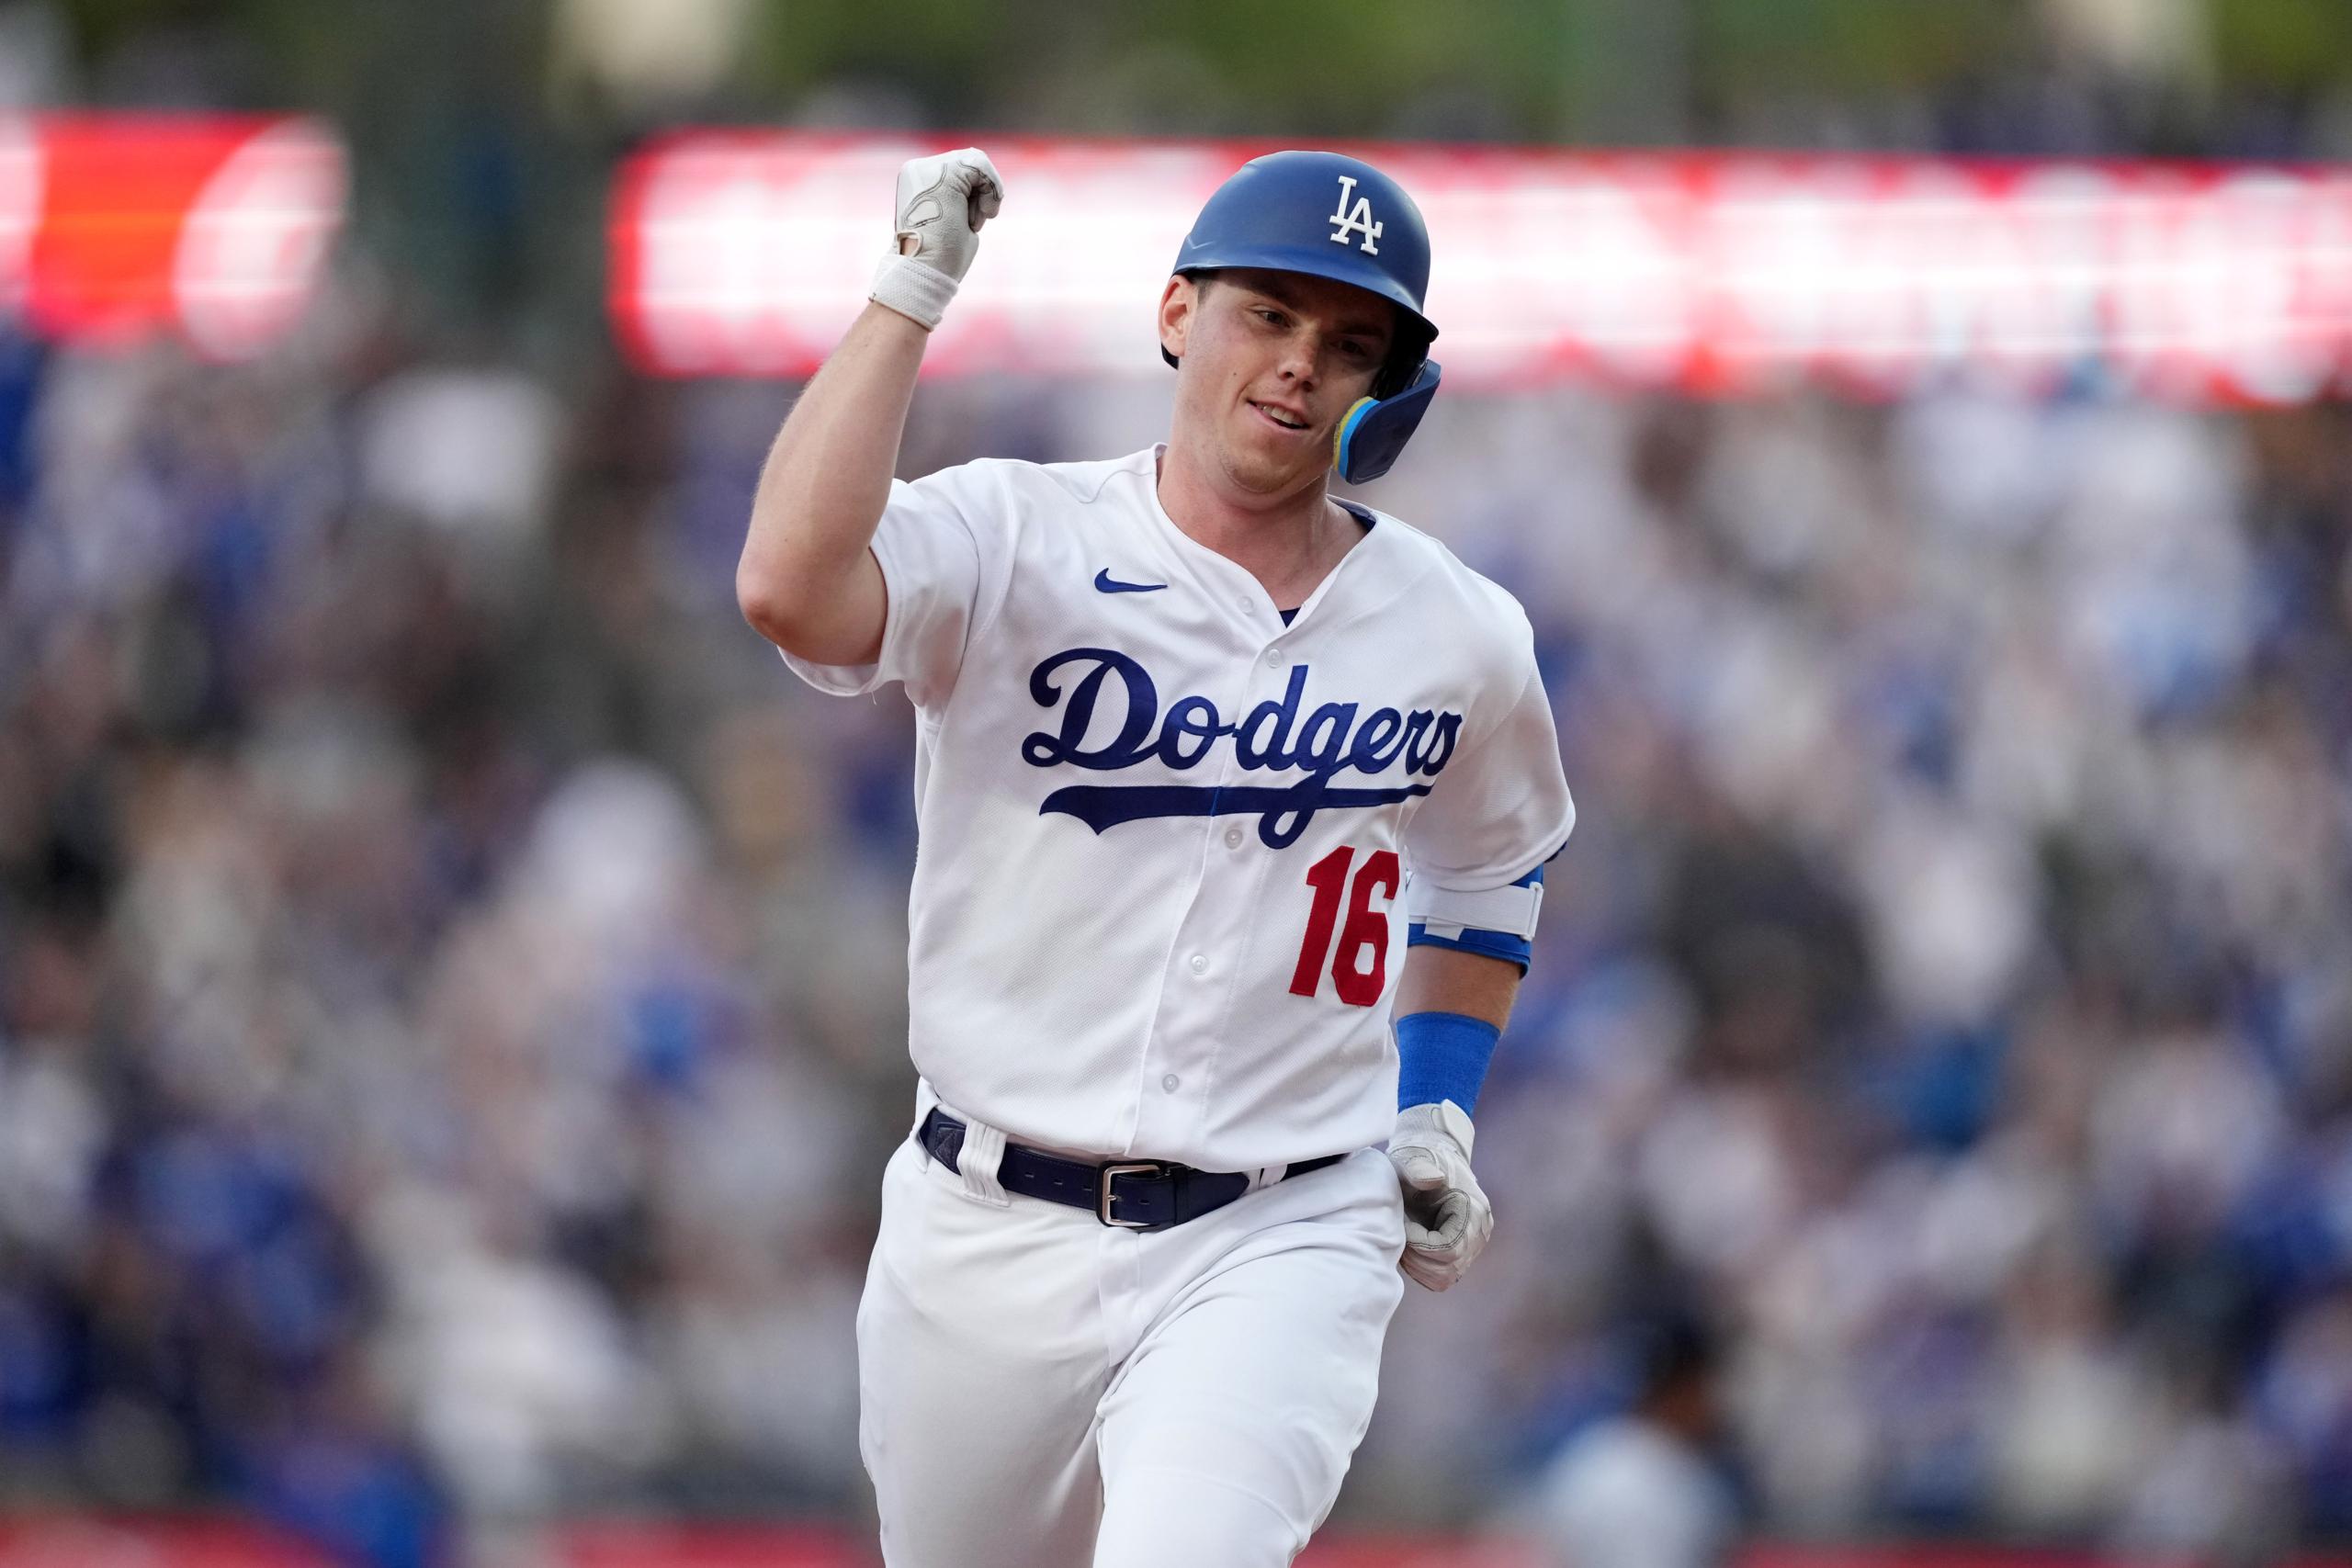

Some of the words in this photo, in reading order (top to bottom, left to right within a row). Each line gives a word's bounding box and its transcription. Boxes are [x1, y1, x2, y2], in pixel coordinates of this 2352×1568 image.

[1329, 175, 1384, 256] LA
[1022, 648, 1463, 850] Dodgers
[1289, 845, 1400, 1008] 16
